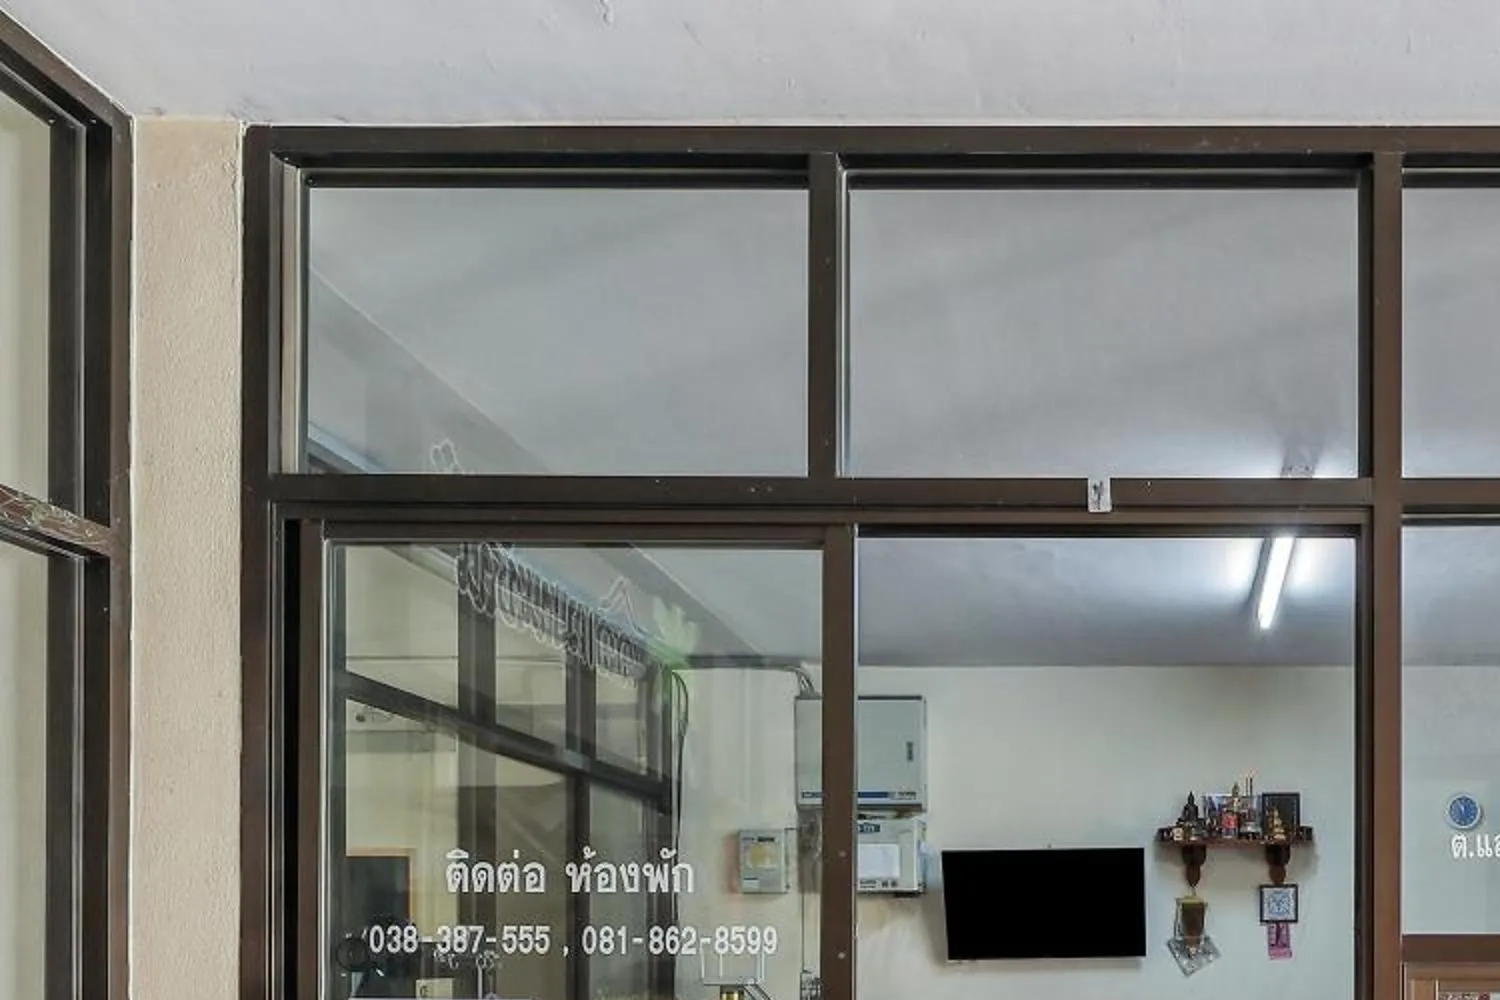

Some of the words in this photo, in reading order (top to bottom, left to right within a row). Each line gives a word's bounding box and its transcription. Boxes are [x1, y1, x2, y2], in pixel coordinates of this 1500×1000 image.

[445, 849, 546, 893] ติดต่อ
[565, 846, 694, 894] ห้องพัก
[369, 925, 550, 956] 038-387-555
[582, 926, 778, 957] 081-862-8599
